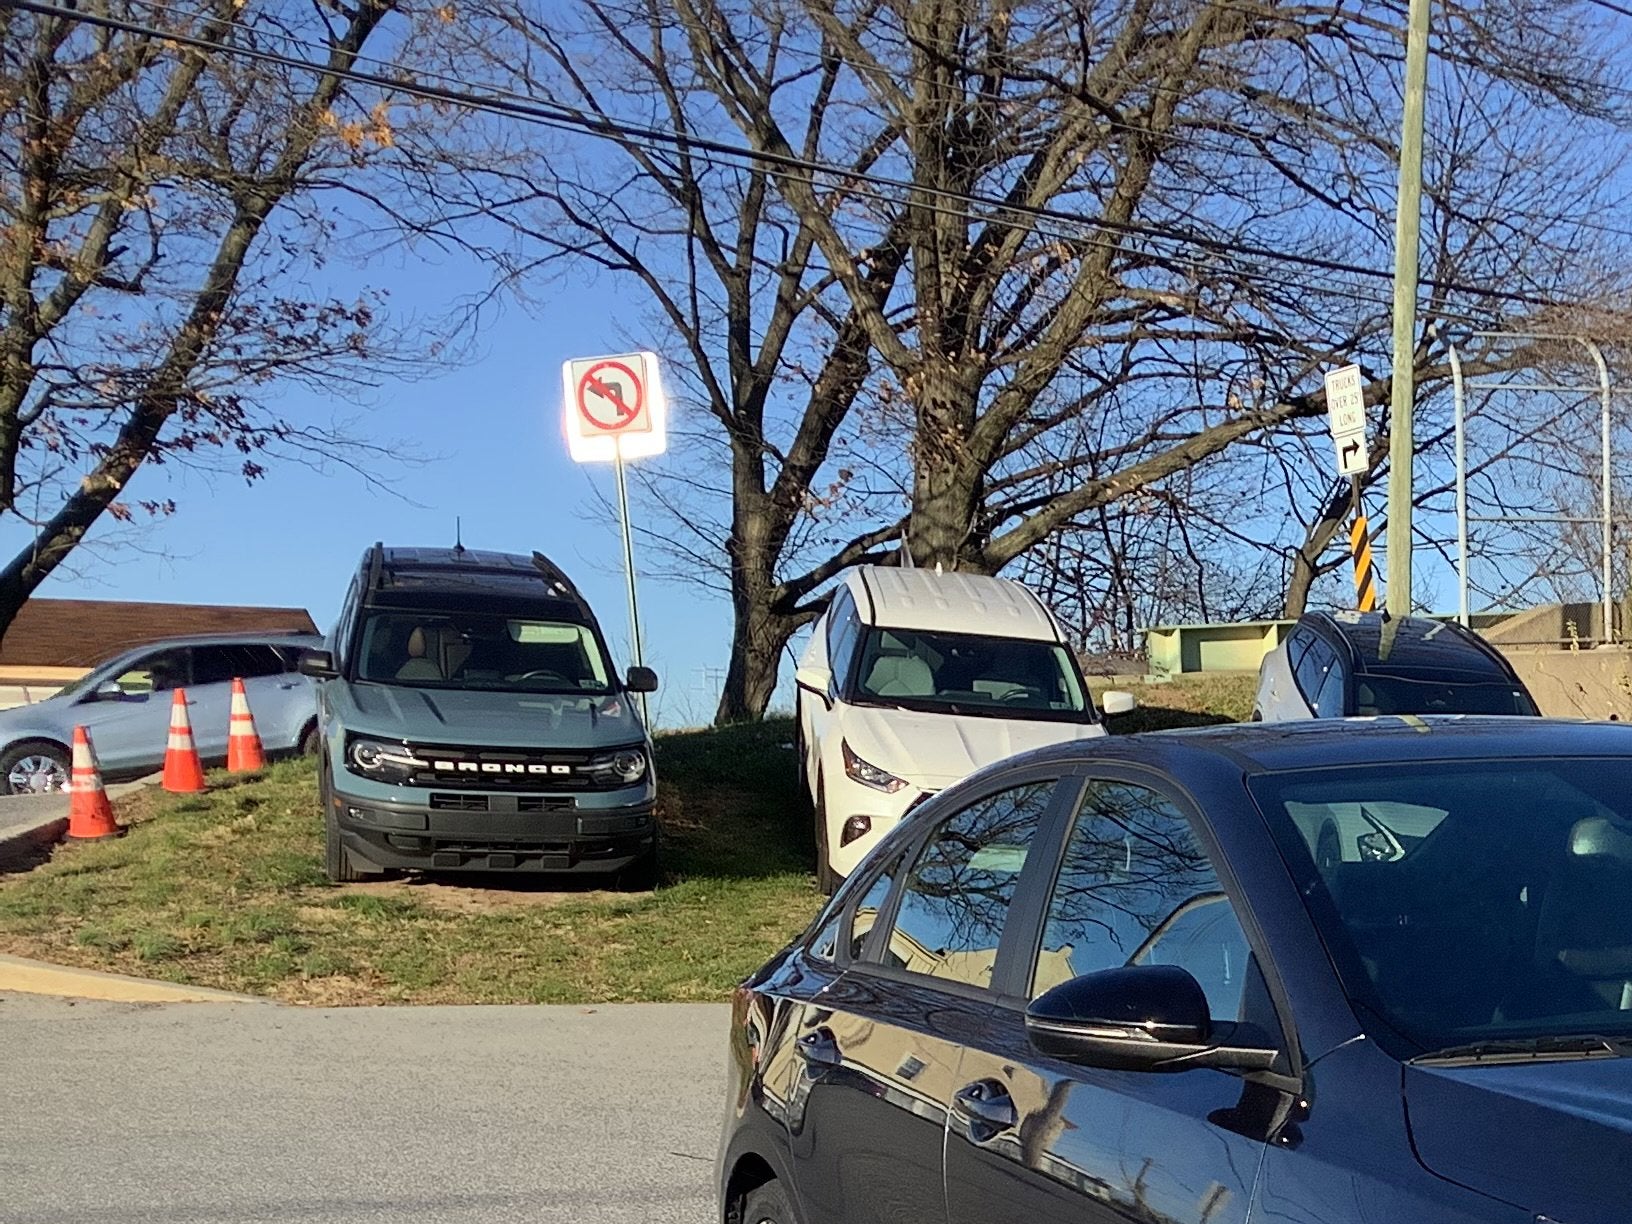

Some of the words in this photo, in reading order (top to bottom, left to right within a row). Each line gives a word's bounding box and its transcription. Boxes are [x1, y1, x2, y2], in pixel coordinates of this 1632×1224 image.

[1331, 374, 1356, 393] TRUCKS
[1331, 395, 1348, 410] OVER
[1339, 411, 1357, 427] LONG
[434, 760, 571, 774] BRONCO
